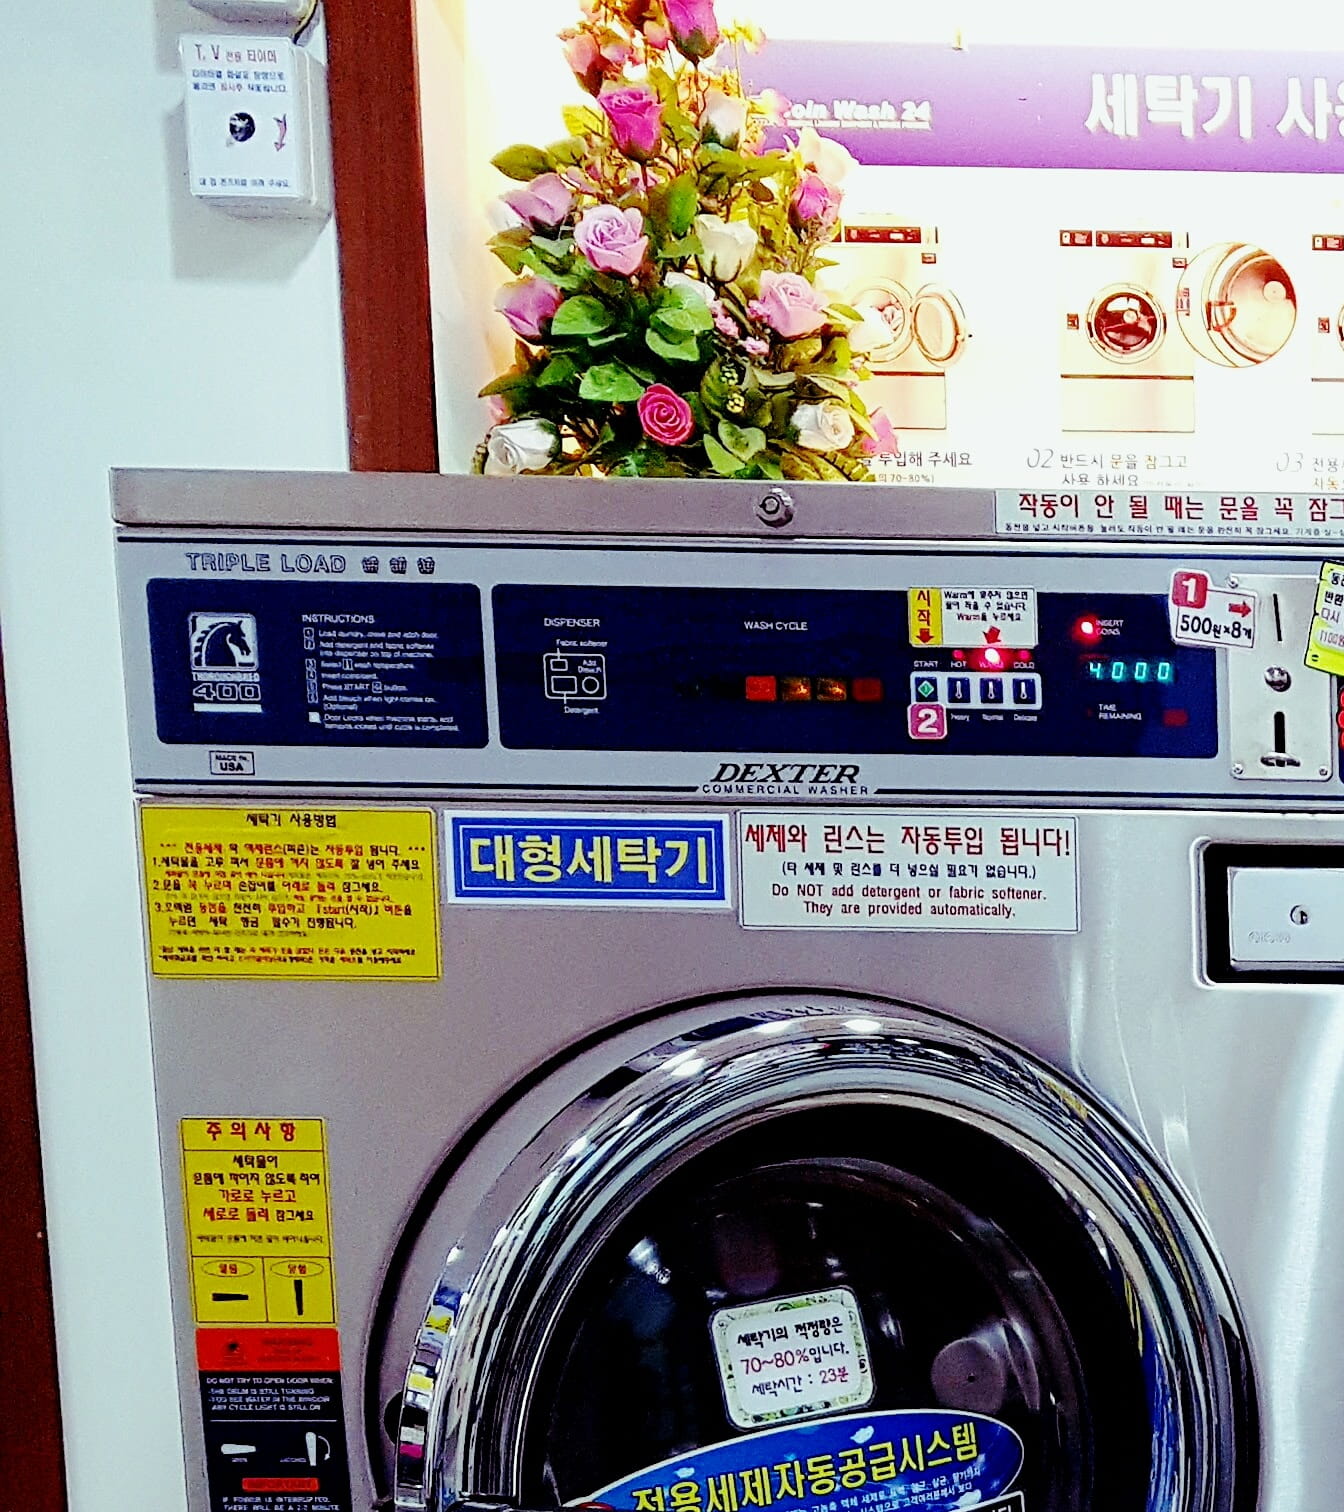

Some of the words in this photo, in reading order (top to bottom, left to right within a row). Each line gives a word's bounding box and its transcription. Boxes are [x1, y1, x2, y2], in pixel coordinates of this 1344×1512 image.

[833, 100, 896, 120] Wash
[902, 101, 931, 121] 24
[1087, 73, 1252, 141] 세탁기
[1019, 493, 1079, 519] 작동이
[1095, 495, 1114, 518] 안
[1129, 496, 1149, 520] 될
[1164, 496, 1205, 520] 때는
[1219, 497, 1259, 521] 문을
[1274, 498, 1294, 521] 꼭
[186, 552, 271, 572] TRIPLE
[280, 553, 346, 573] LOAD
[1182, 577, 1197, 603] 1
[301, 614, 375, 624] INSTRUCTIONS
[544, 618, 600, 627] DISPENSER
[744, 621, 773, 630] WASH
[775, 622, 808, 631] CYCLE
[1089, 662, 1171, 681] 4000
[193, 683, 261, 700] 400
[918, 708, 938, 734] 2
[220, 762, 243, 771] USA
[710, 763, 860, 784] DEXTER
[702, 784, 800, 795] COMMERCIAL
[808, 786, 868, 795] WASHER
[746, 824, 807, 853] 세제와
[824, 825, 884, 853] 린스는
[901, 826, 983, 856] 자동투입
[1001, 827, 1070, 856] 됩니다!
[470, 834, 709, 885] 대형세탁기
[772, 884, 789, 897] Do
[798, 884, 823, 897] NOT
[832, 884, 854, 897] add
[862, 884, 920, 900] detergent
[928, 887, 941, 898] or
[949, 885, 984, 899] fabric
[992, 885, 1047, 900] softener.
[804, 901, 833, 917] They
[841, 904, 860, 914] are
[868, 901, 922, 917] provided
[930, 903, 1016, 919] automatically.
[751, 1375, 803, 1397] 세탁시간
[819, 1366, 849, 1384] 23분
